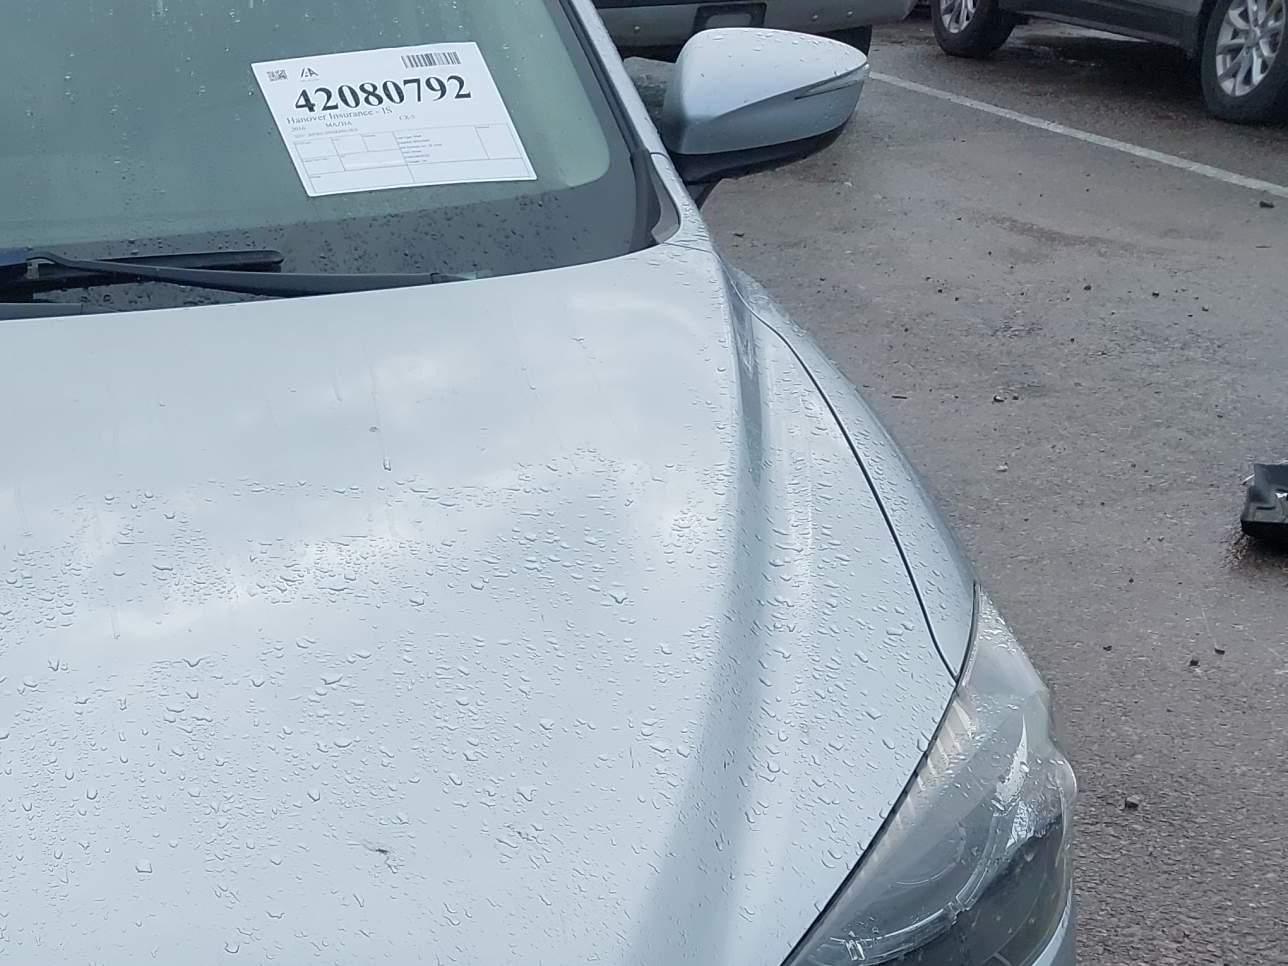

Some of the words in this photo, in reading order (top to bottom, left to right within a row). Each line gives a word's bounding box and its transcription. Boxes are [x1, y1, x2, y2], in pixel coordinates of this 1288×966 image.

[295, 75, 472, 112] 42080792
[286, 115, 326, 124] Hanover
[328, 110, 374, 120] Insurance
